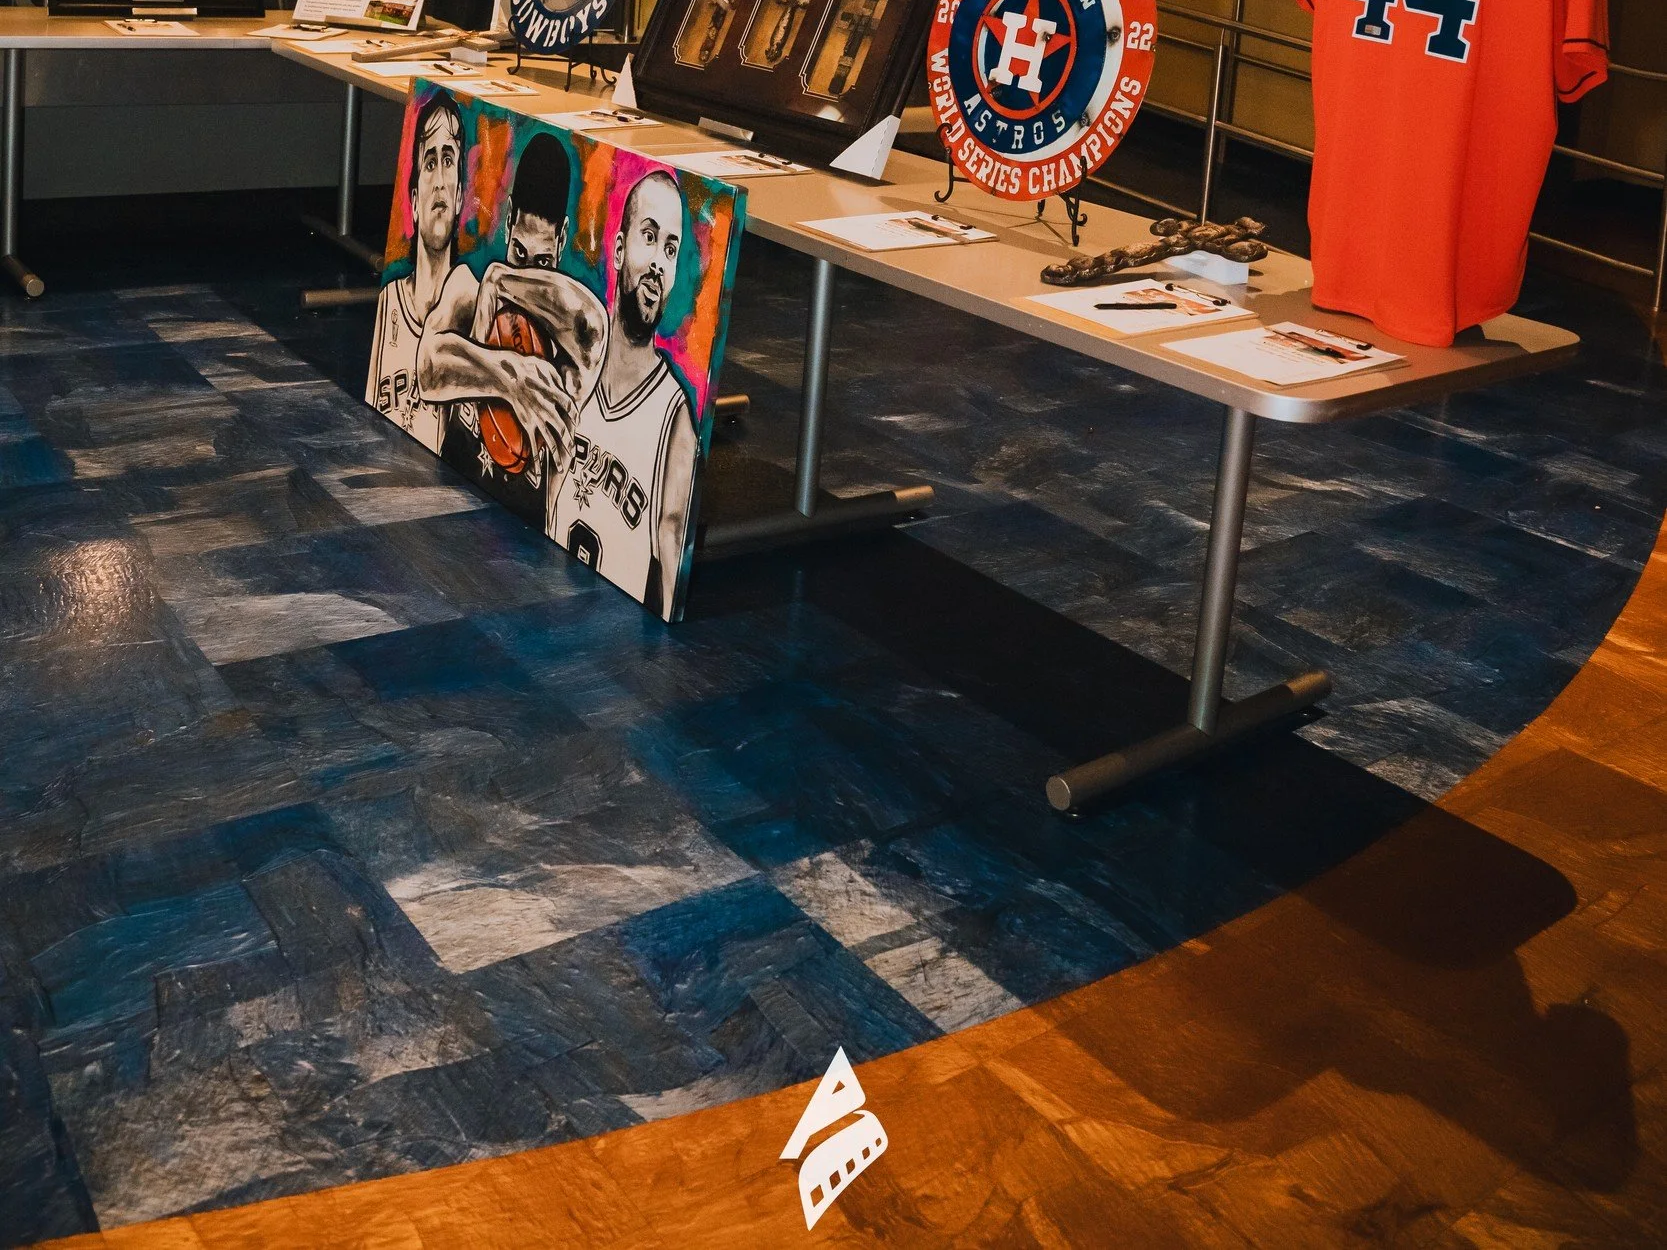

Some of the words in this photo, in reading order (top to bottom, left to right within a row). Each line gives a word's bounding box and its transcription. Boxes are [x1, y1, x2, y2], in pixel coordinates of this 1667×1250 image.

[989, 11, 1057, 93] H
[1126, 21, 1155, 51] 22
[931, 47, 966, 143] WORLD
[957, 137, 1022, 194] SERIES
[1028, 76, 1142, 195] CHAMPIONS
[964, 92, 1066, 149] ASTROS
